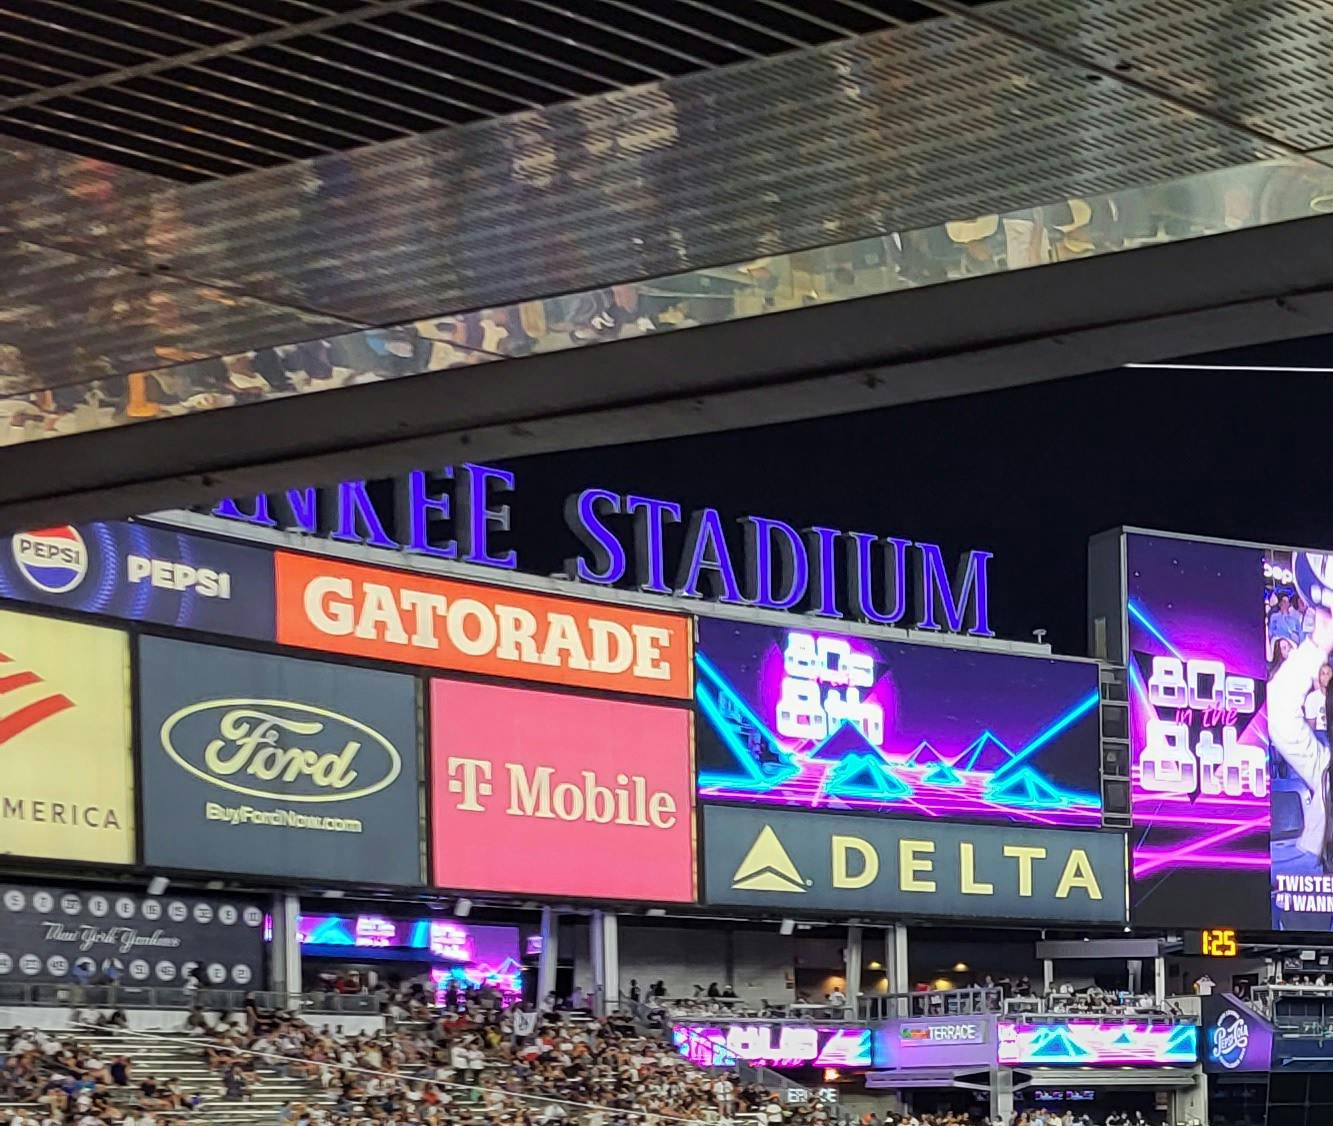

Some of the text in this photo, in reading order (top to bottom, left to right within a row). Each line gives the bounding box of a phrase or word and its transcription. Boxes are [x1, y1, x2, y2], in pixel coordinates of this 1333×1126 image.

[20, 538, 81, 564] PEPSI
[126, 554, 232, 600] PEPSI
[576, 487, 996, 638] STADIUM
[303, 575, 672, 682] GATORADE
[1148, 655, 1256, 714] 80s
[1175, 701, 1239, 727] in the
[205, 709, 360, 789] Ford
[1139, 718, 1267, 798] 8th
[205, 801, 363, 834] BuyFordNow.com
[505, 762, 678, 830] Mobile
[831, 834, 1103, 900] DELTA
[1202, 930, 1236, 956] 1:25
[927, 1024, 976, 1041] TERRACE
